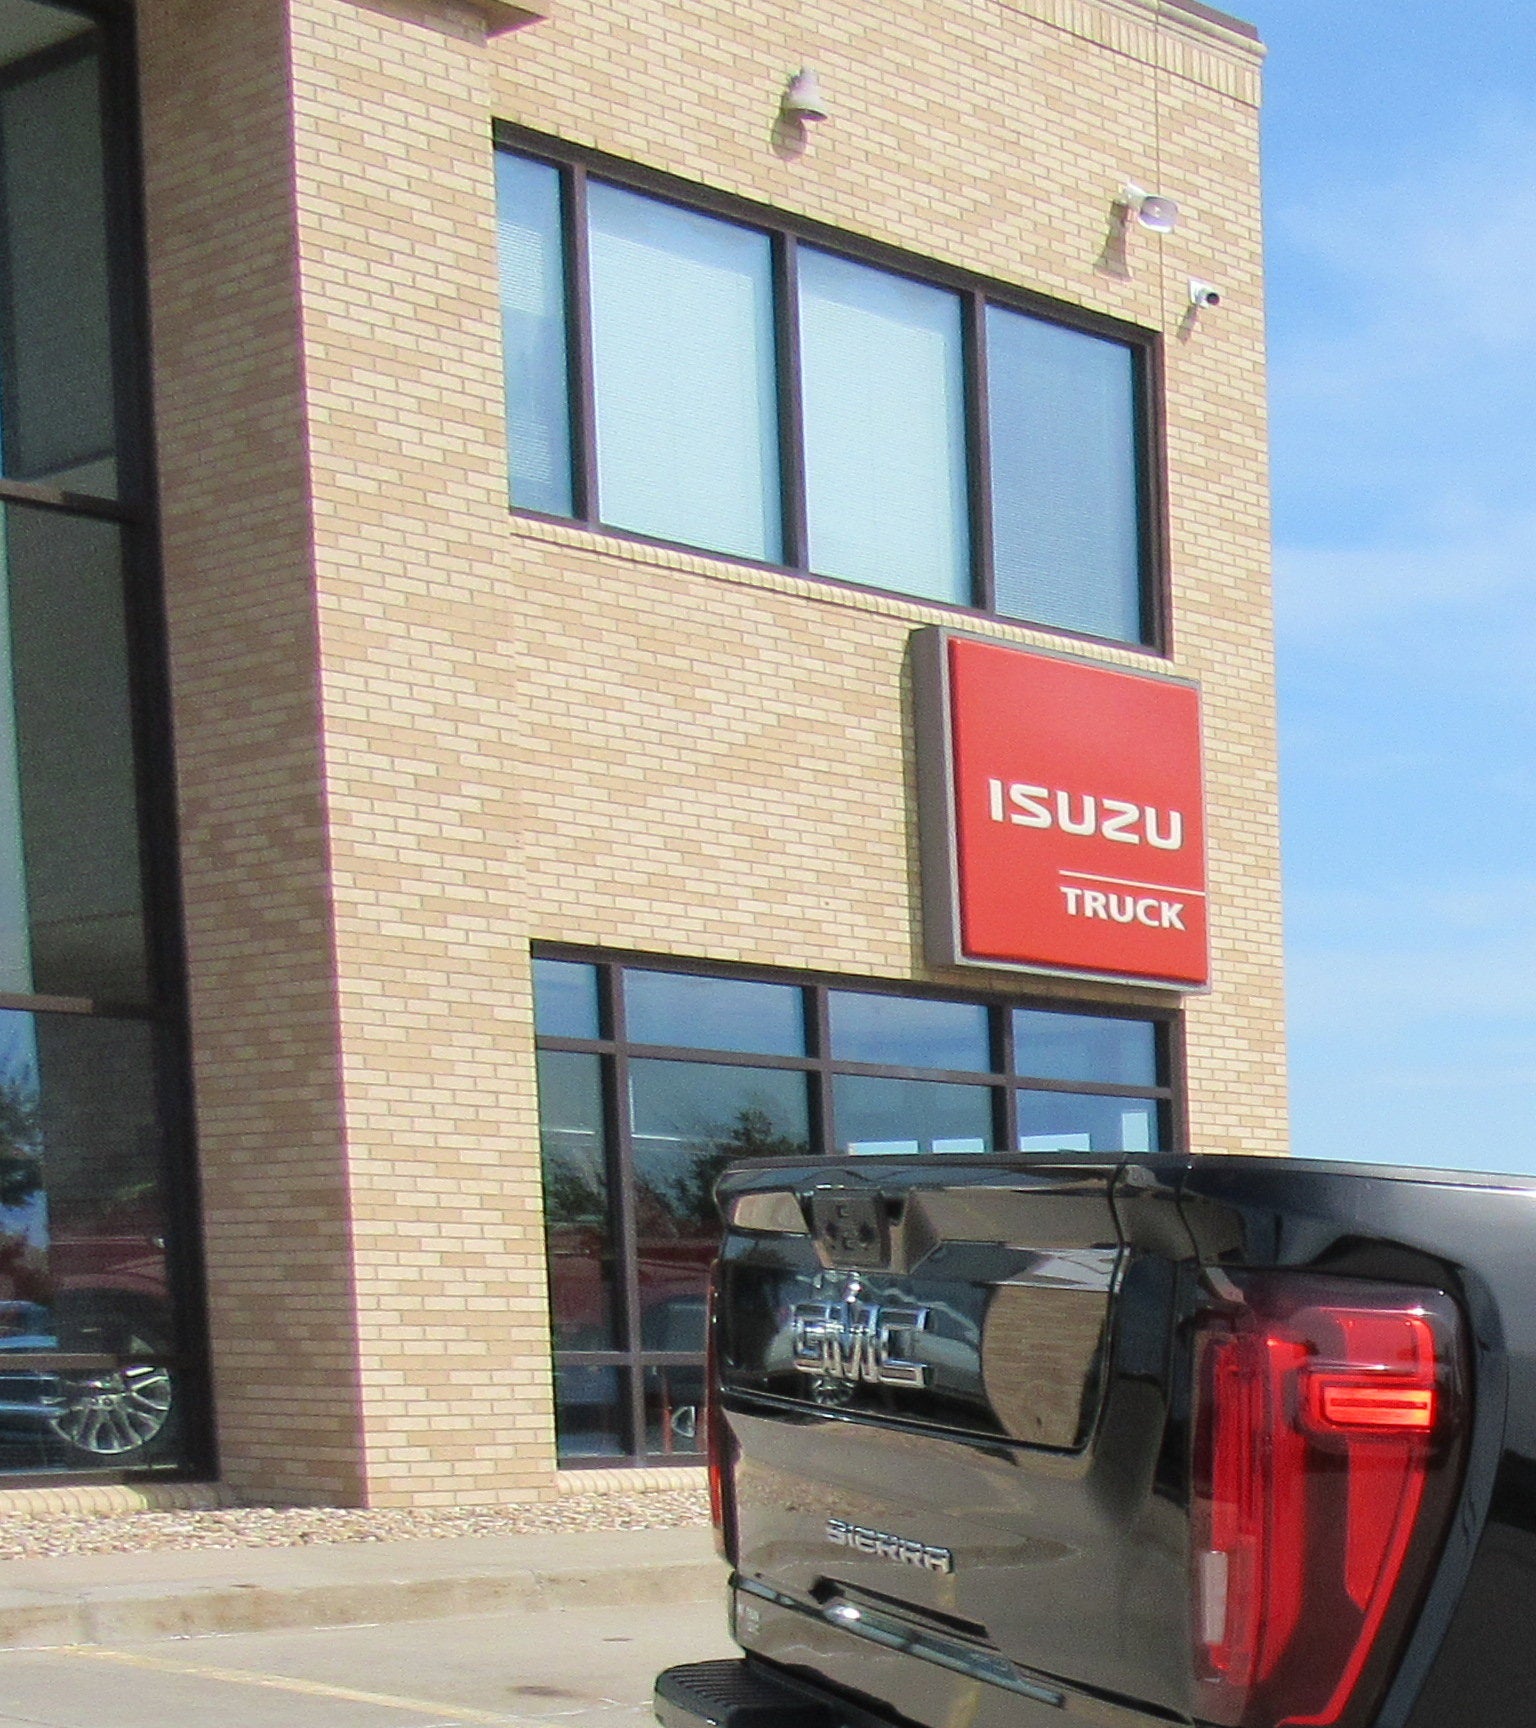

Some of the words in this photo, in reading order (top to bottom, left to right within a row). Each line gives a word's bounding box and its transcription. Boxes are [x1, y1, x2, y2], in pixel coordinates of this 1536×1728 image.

[988, 778, 1183, 851] ISUZU
[1059, 886, 1186, 931] TRUCK
[790, 1302, 930, 1389] GMC
[825, 1518, 953, 1574] SIERRA
